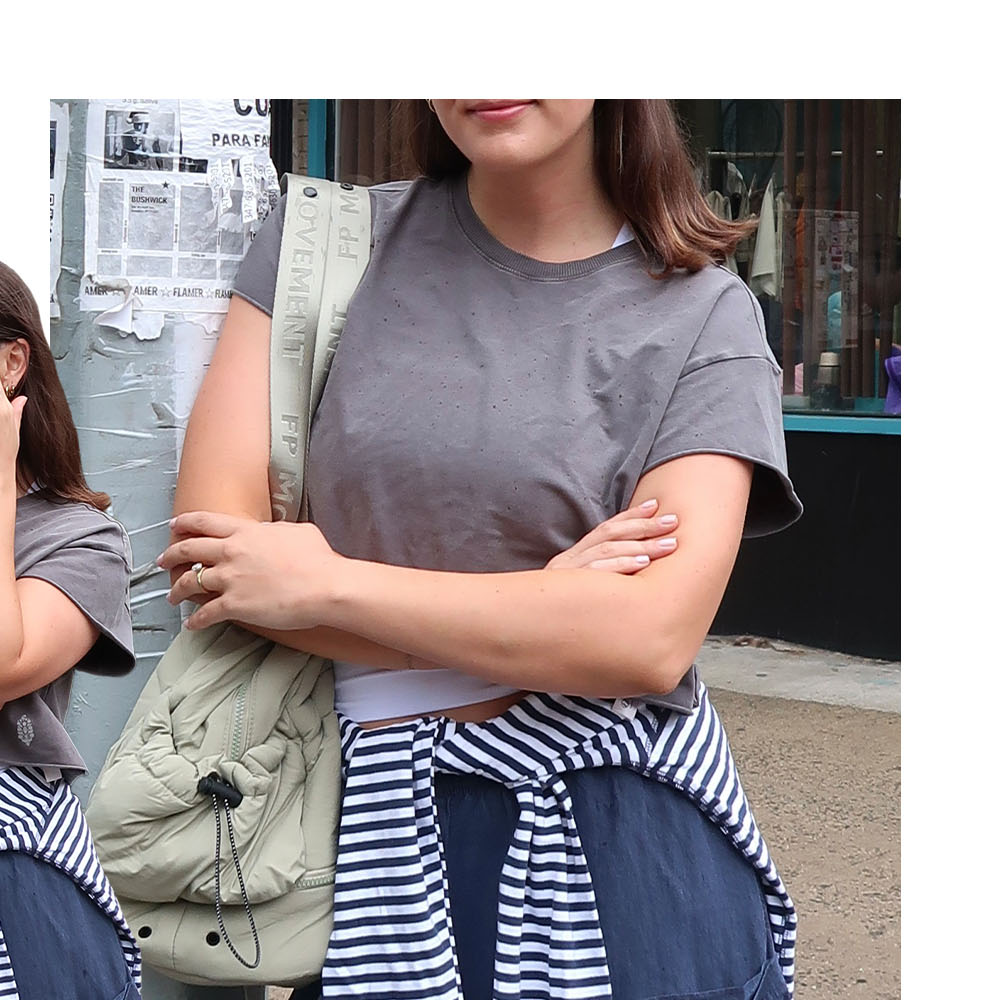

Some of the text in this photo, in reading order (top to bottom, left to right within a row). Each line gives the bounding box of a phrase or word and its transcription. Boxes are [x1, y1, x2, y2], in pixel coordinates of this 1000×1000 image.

[212, 133, 271, 148] PARA FA
[131, 196, 168, 204] BUSHWICK
[173, 287, 204, 298] FLAMER
[280, 413, 299, 457] FP
